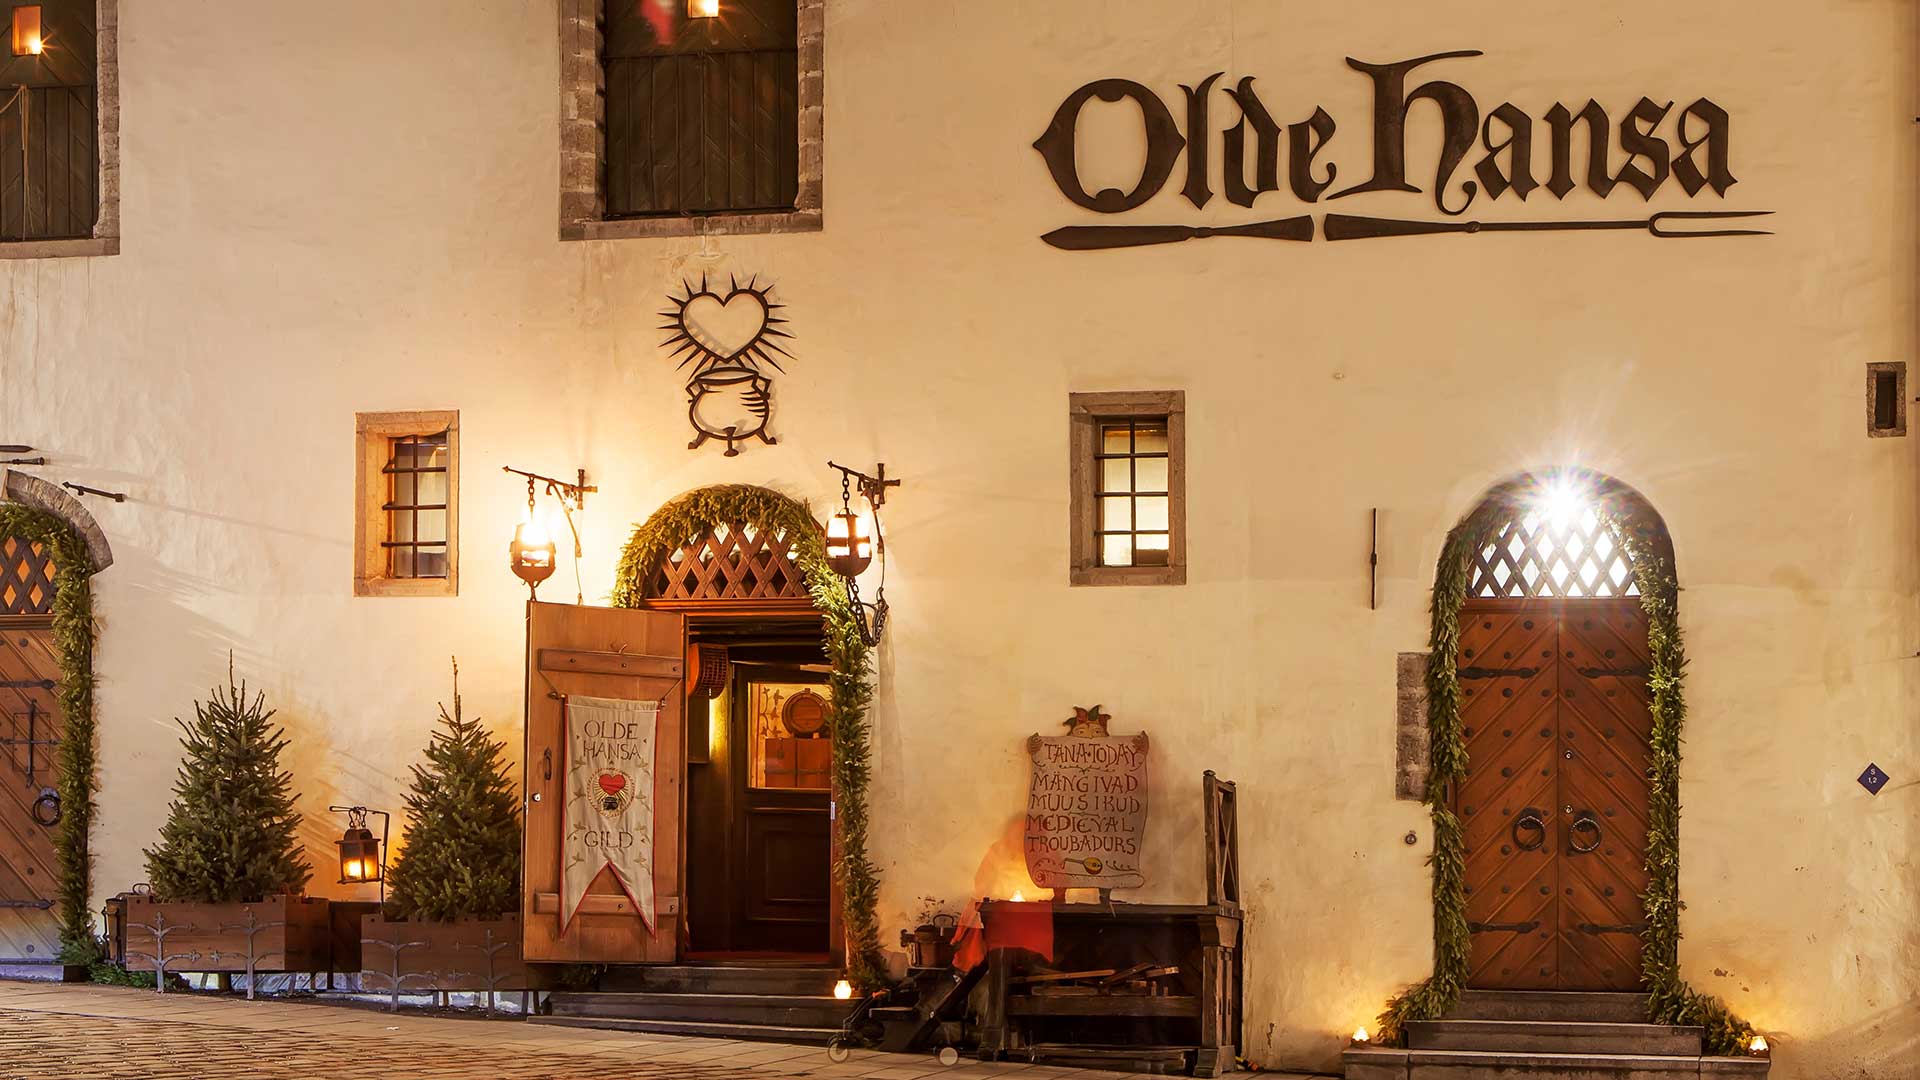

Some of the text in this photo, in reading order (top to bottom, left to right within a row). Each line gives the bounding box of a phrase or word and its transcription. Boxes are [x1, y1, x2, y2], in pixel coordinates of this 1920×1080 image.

[1032, 50, 1739, 216] Olde Hansa
[584, 719, 639, 740] OLDE
[582, 739, 642, 760] HANSA
[1027, 813, 1135, 833] MEDIEVAL
[584, 830, 634, 848] GILD
[1028, 835, 1136, 855] TROUBADURS
